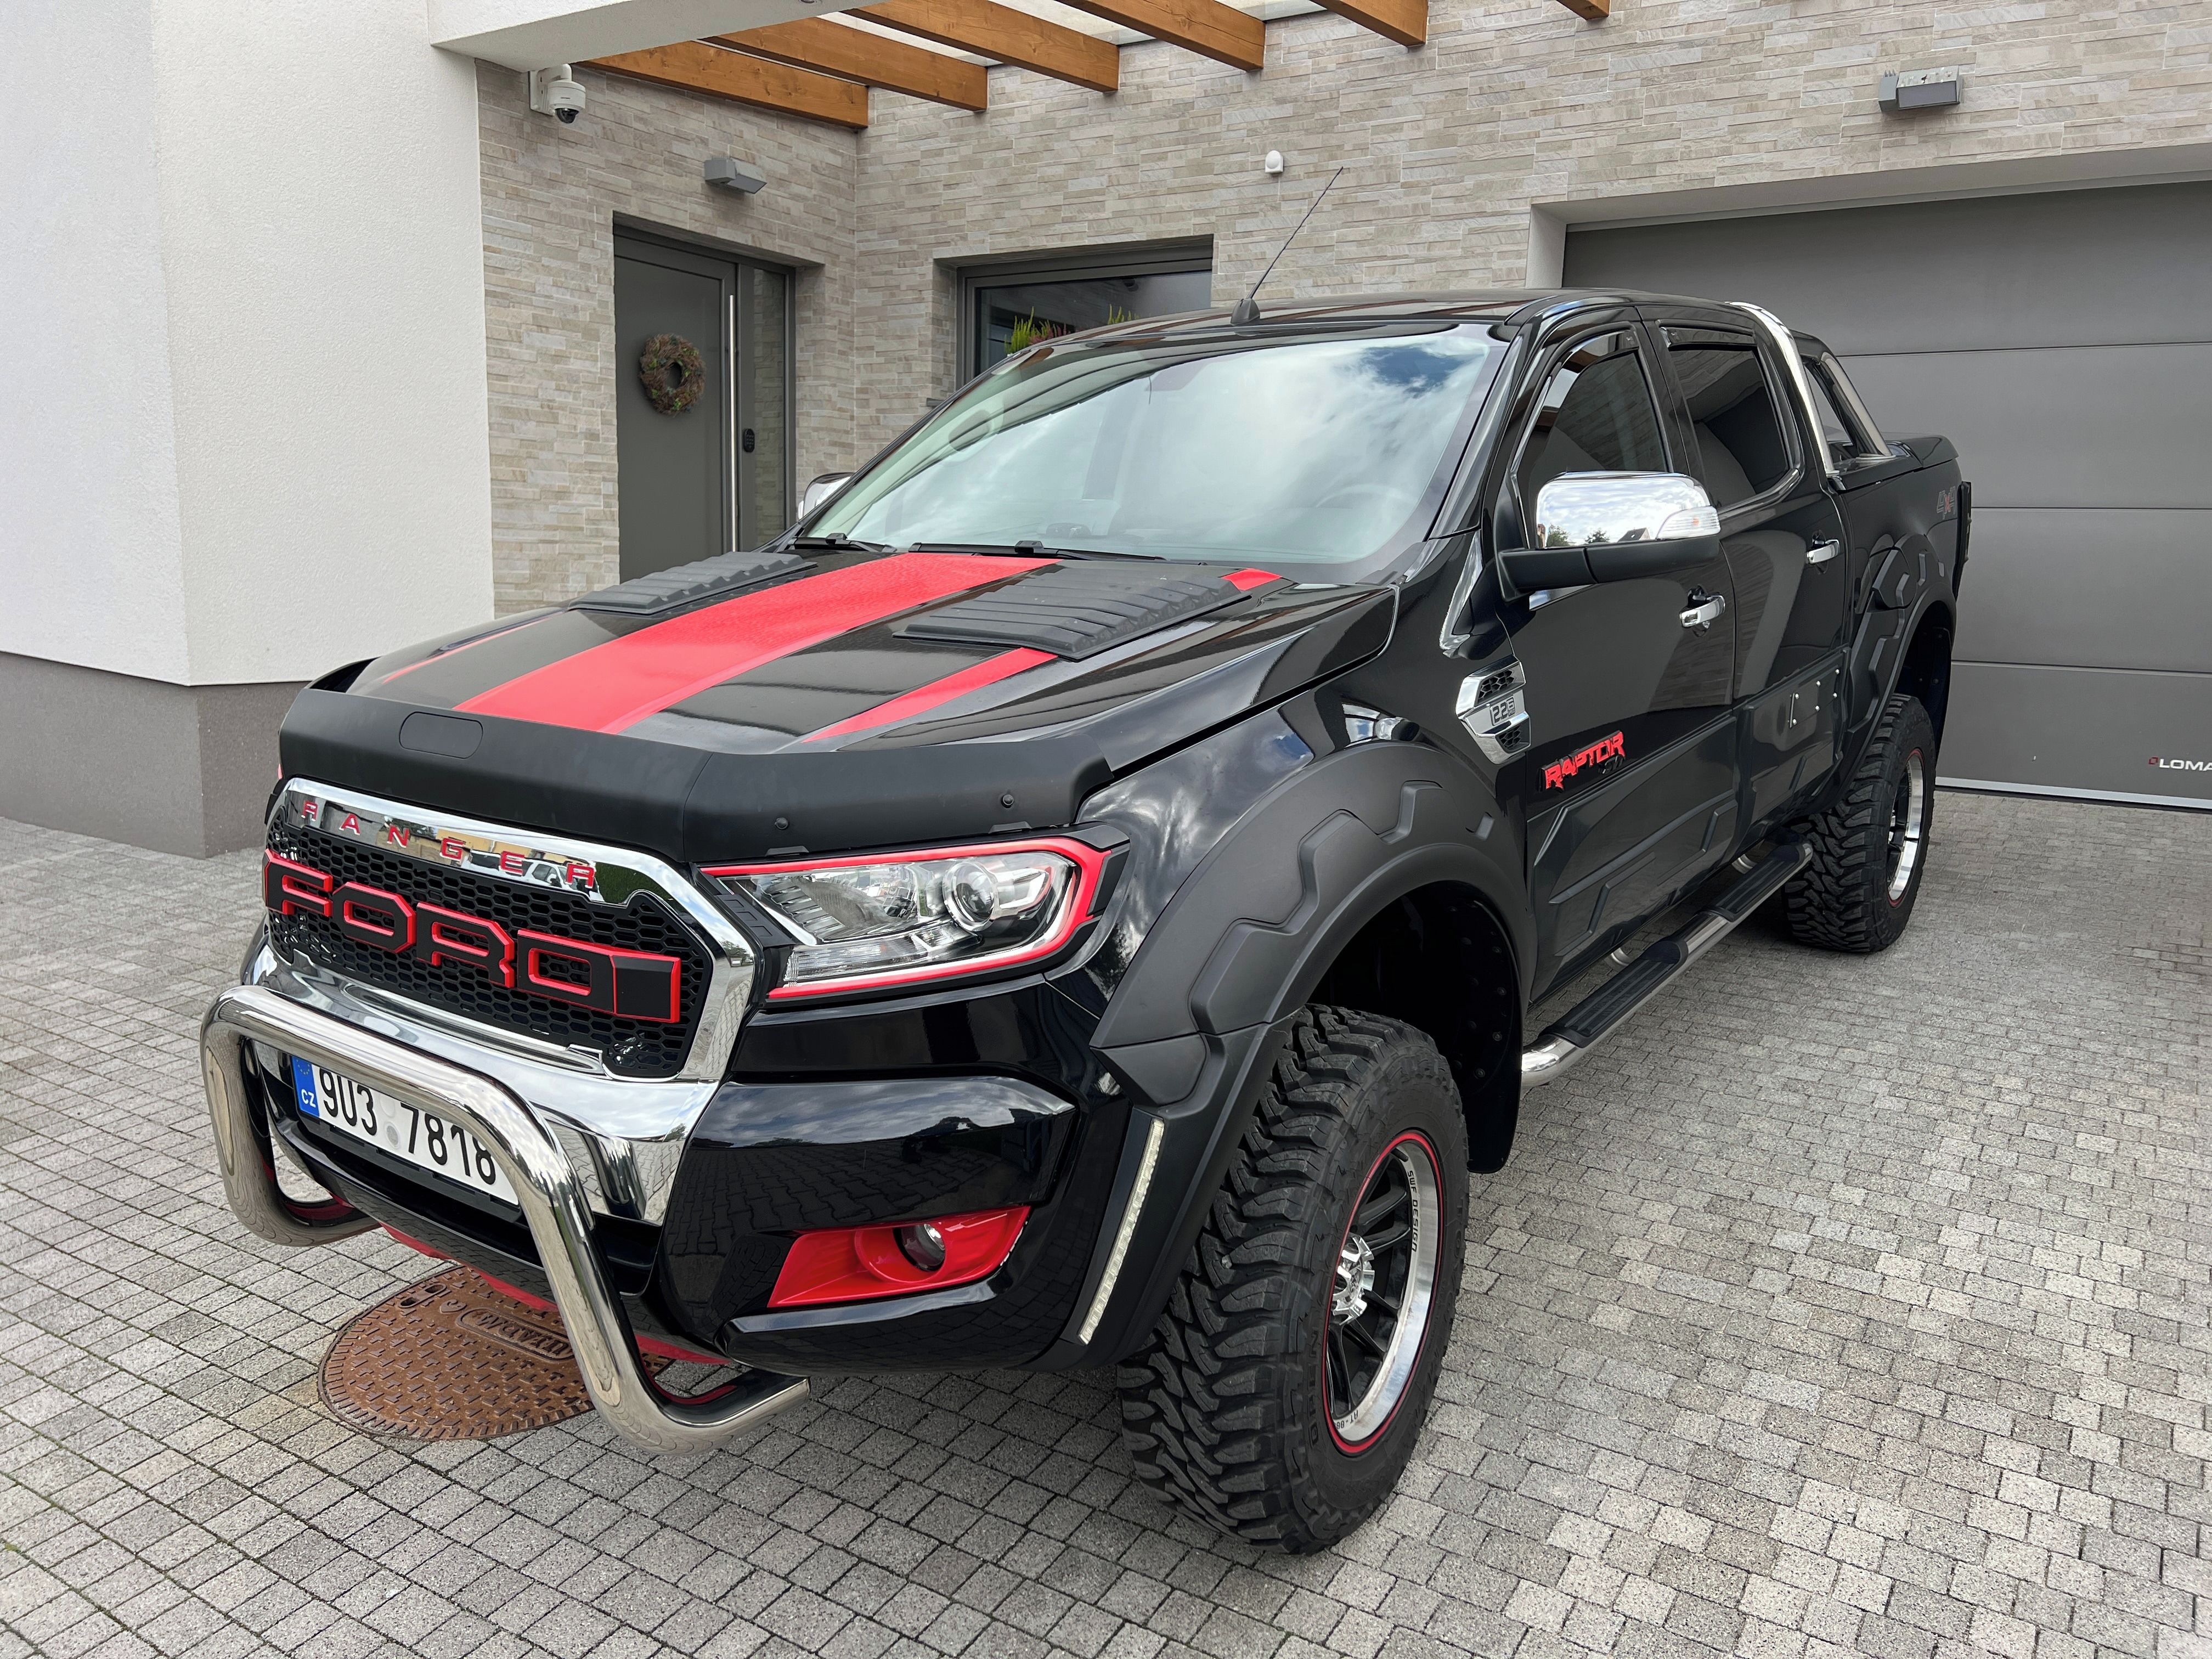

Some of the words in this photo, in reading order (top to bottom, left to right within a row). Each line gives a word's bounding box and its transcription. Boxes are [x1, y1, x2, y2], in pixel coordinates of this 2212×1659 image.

[1544, 731, 1626, 790] RAPTOR
[301, 800, 596, 889] RANGER
[264, 849, 680, 1023] FORD
[301, 1088, 316, 1108] CZ
[400, 1102, 496, 1185] 7818
[1407, 1170, 1417, 1194] SWF
[1334, 1409, 1358, 1430] AT-86
